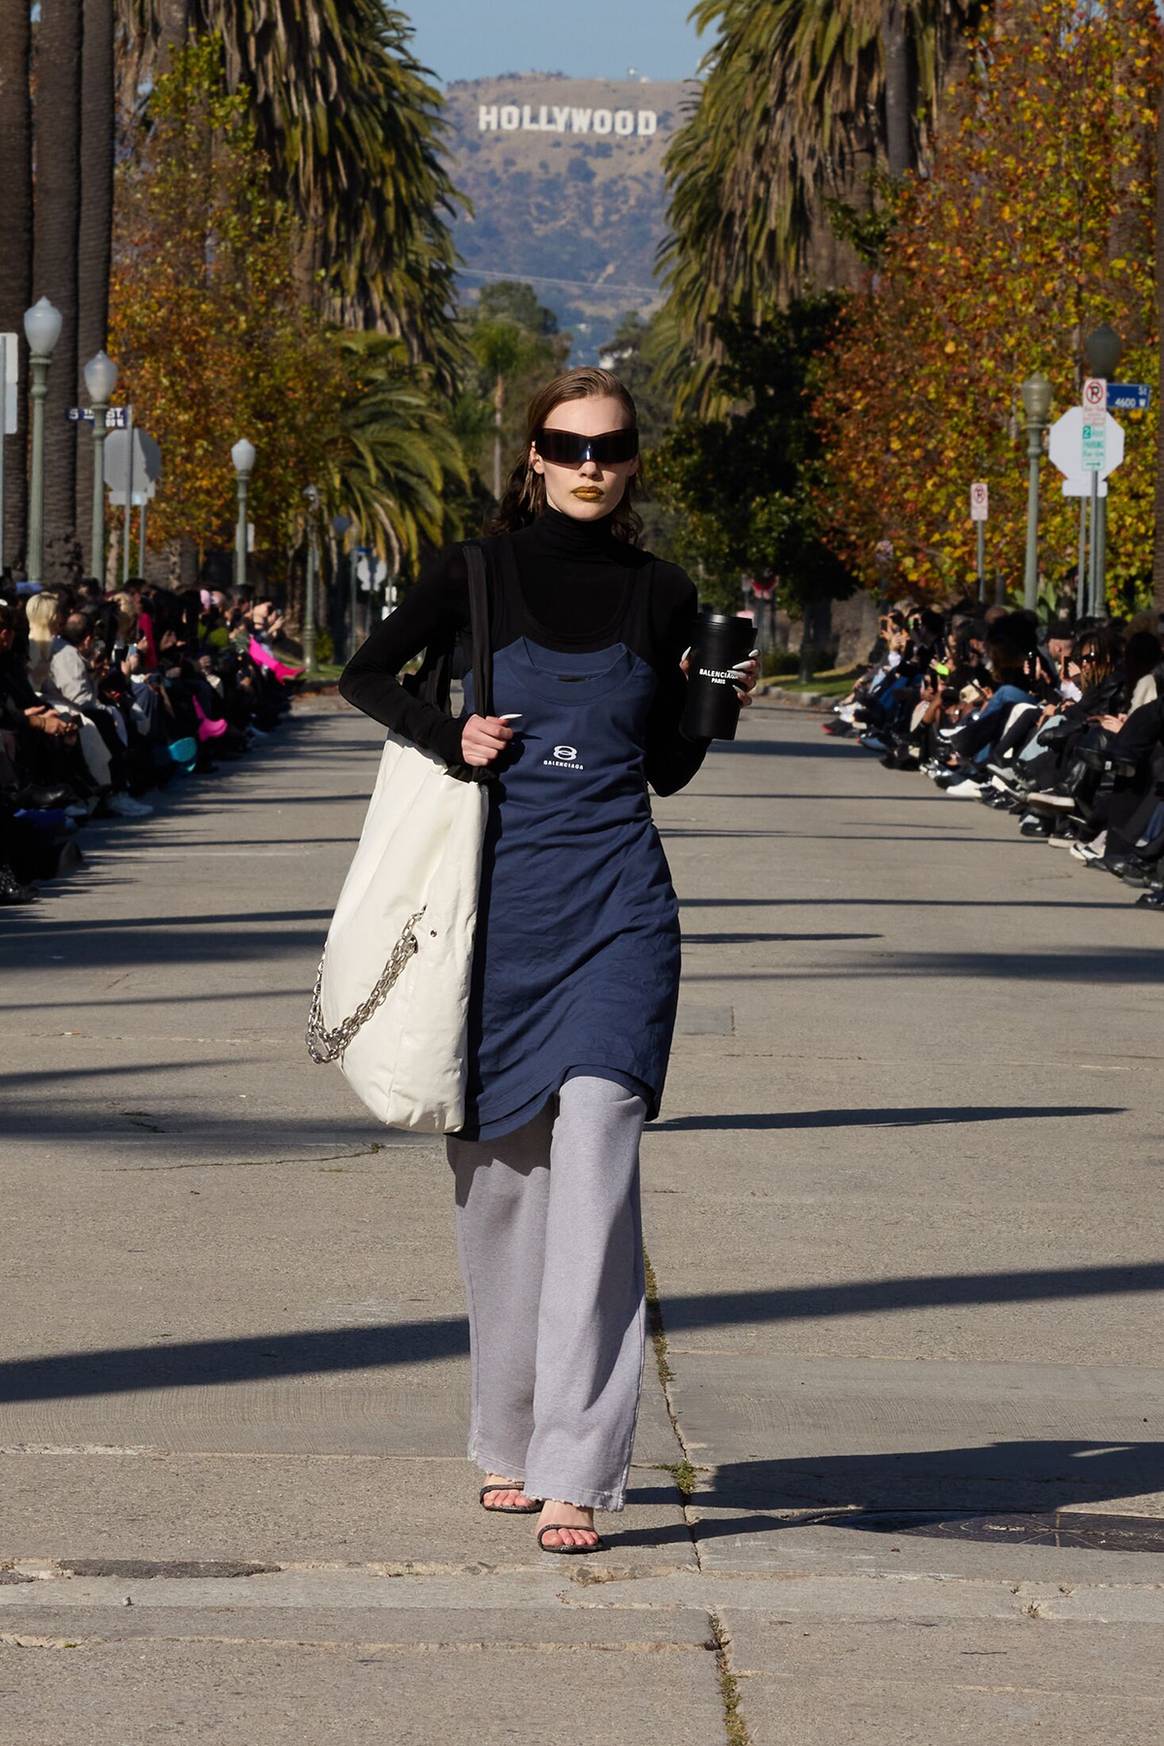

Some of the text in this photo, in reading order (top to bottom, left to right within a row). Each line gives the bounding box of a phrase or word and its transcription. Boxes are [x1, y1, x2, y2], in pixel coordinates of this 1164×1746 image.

[478, 105, 658, 136] HOLLYWOOD
[1115, 398, 1137, 408] 4600
[711, 677, 726, 685] PARIS
[543, 760, 584, 770] BALENCIAGA
